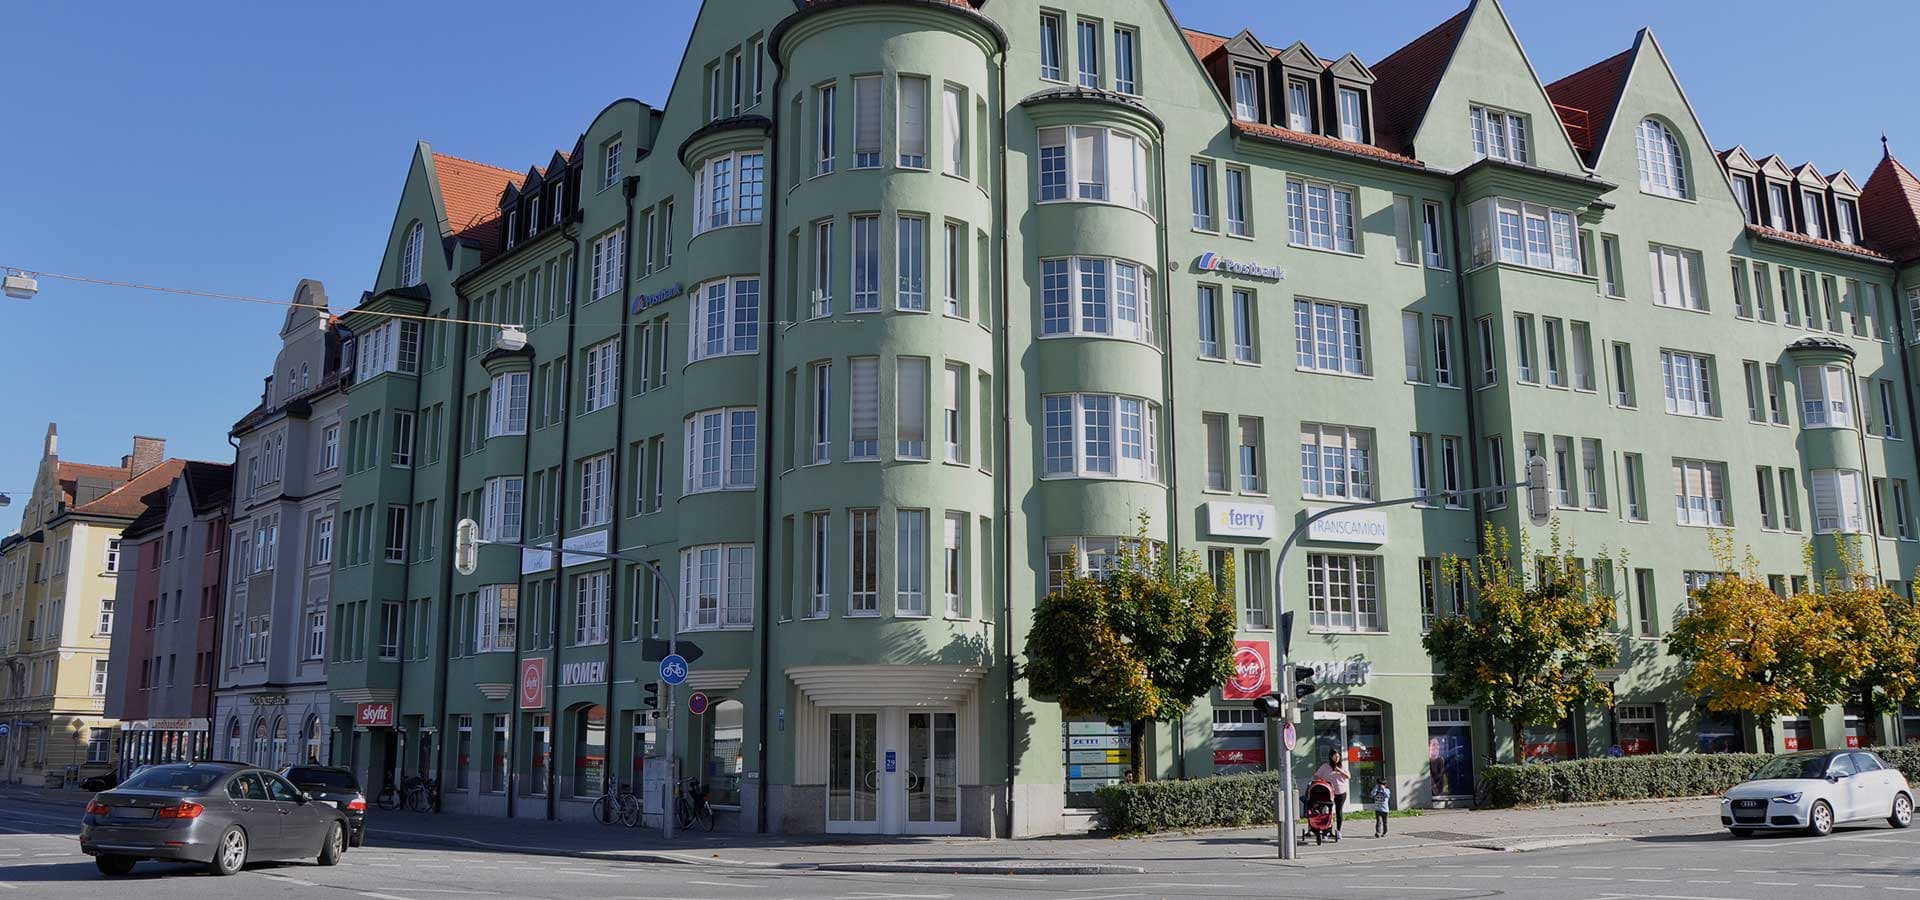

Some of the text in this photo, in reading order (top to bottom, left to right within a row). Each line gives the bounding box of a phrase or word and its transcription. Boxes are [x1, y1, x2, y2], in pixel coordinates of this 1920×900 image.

[1225, 258, 1285, 280] Postbank
[1221, 508, 1264, 530] aferry
[1313, 517, 1385, 536] TRANSCAMION
[563, 662, 605, 684] WOMEN
[362, 704, 389, 723] skyfit
